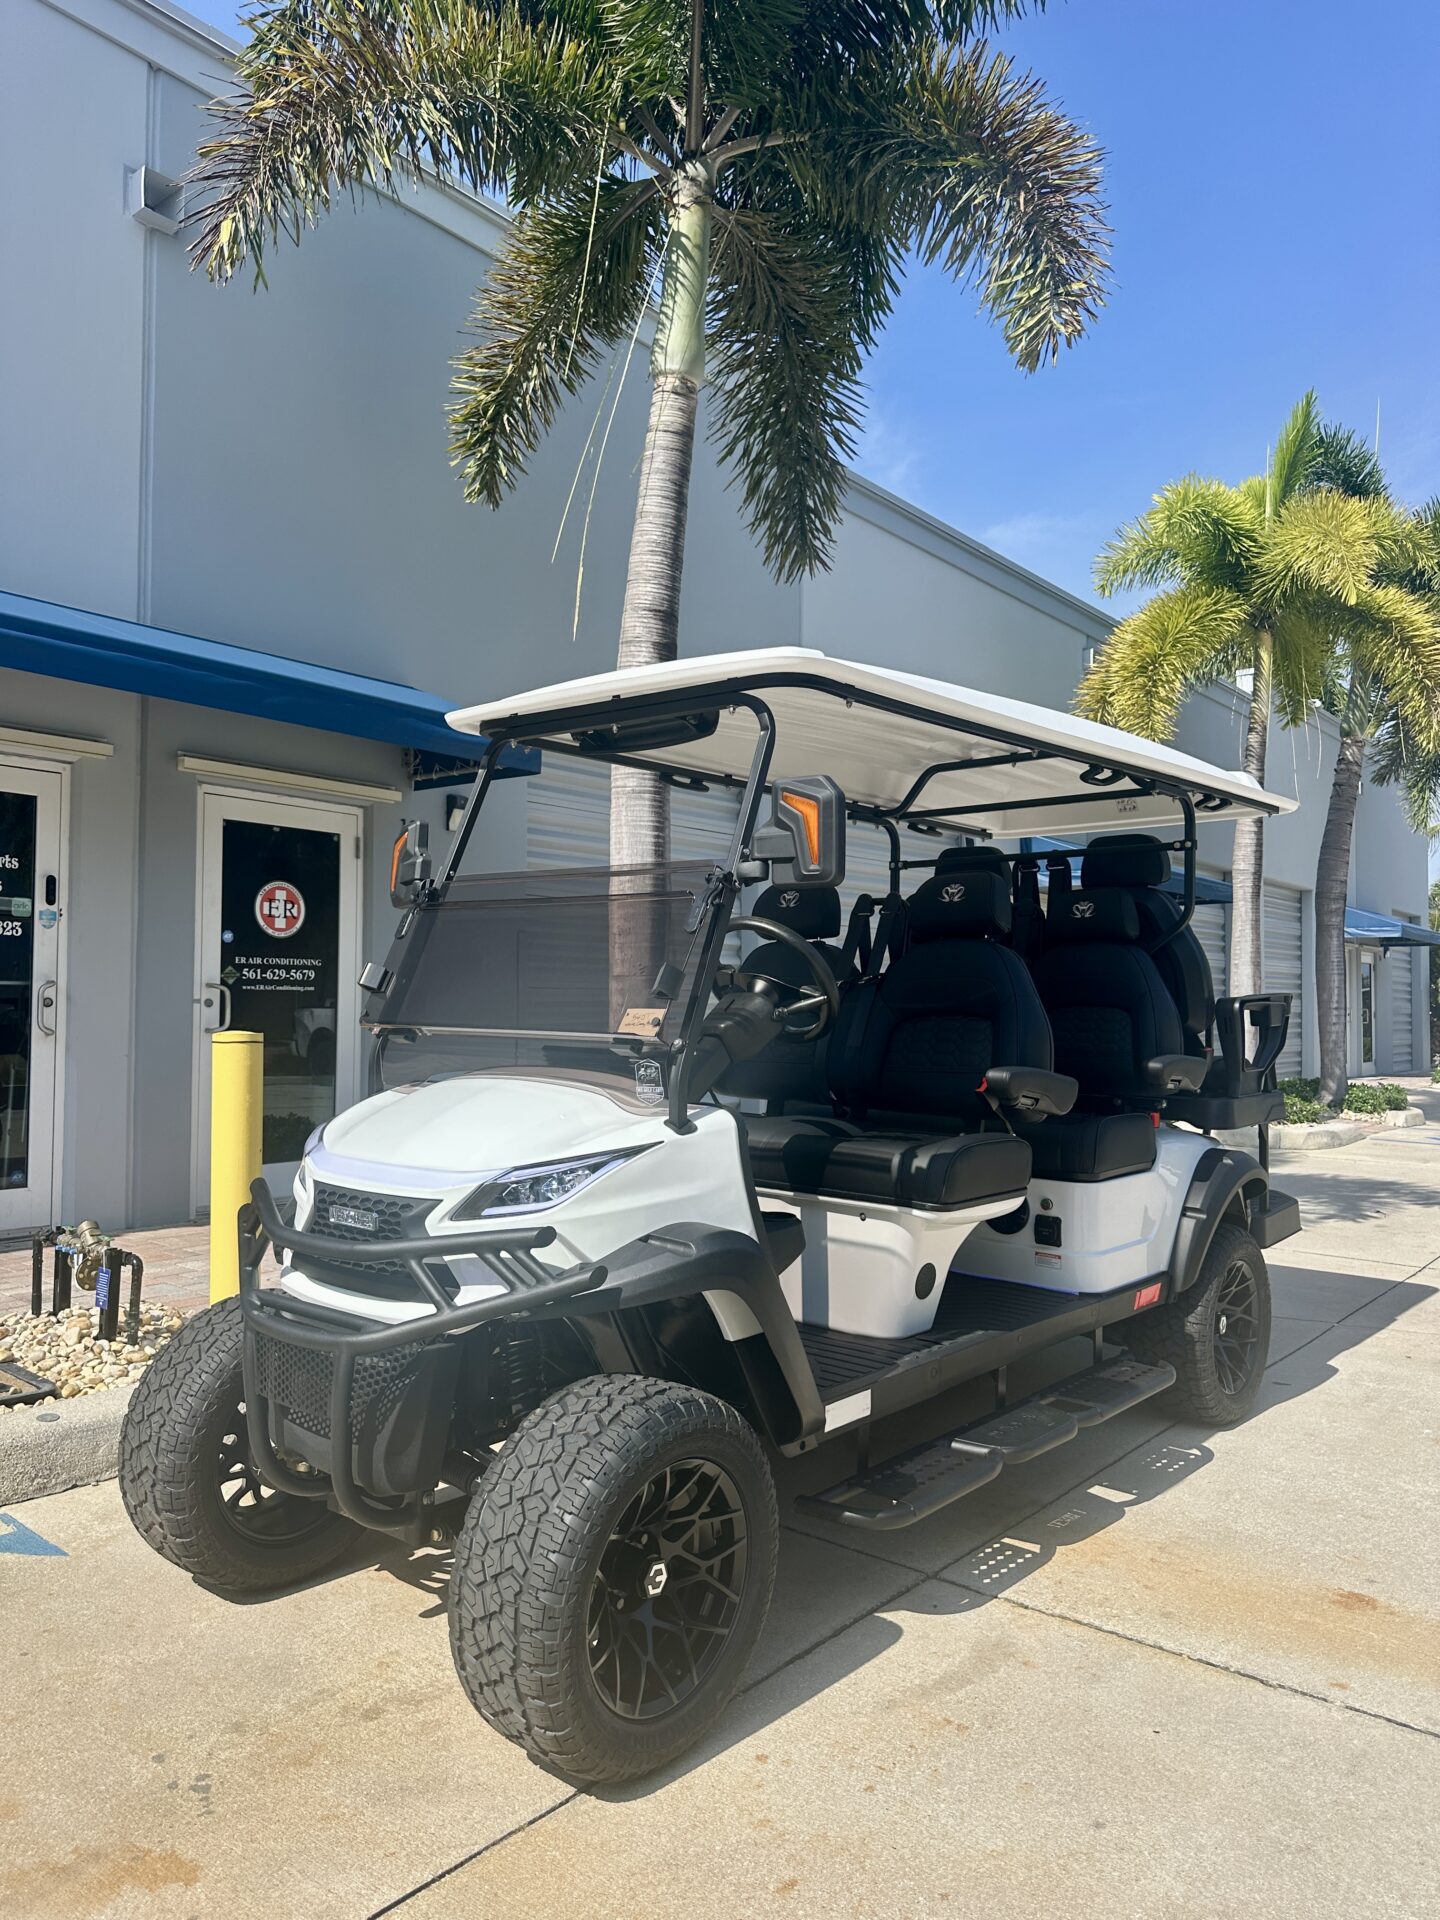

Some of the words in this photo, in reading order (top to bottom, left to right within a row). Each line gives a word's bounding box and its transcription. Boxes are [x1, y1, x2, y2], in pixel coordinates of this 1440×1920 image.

[267, 898, 297, 919] ER
[235, 956, 246, 964] ER
[248, 957, 262, 965] AIR
[263, 957, 322, 966] CONDITIONING
[242, 968, 315, 981] 561-629-5679
